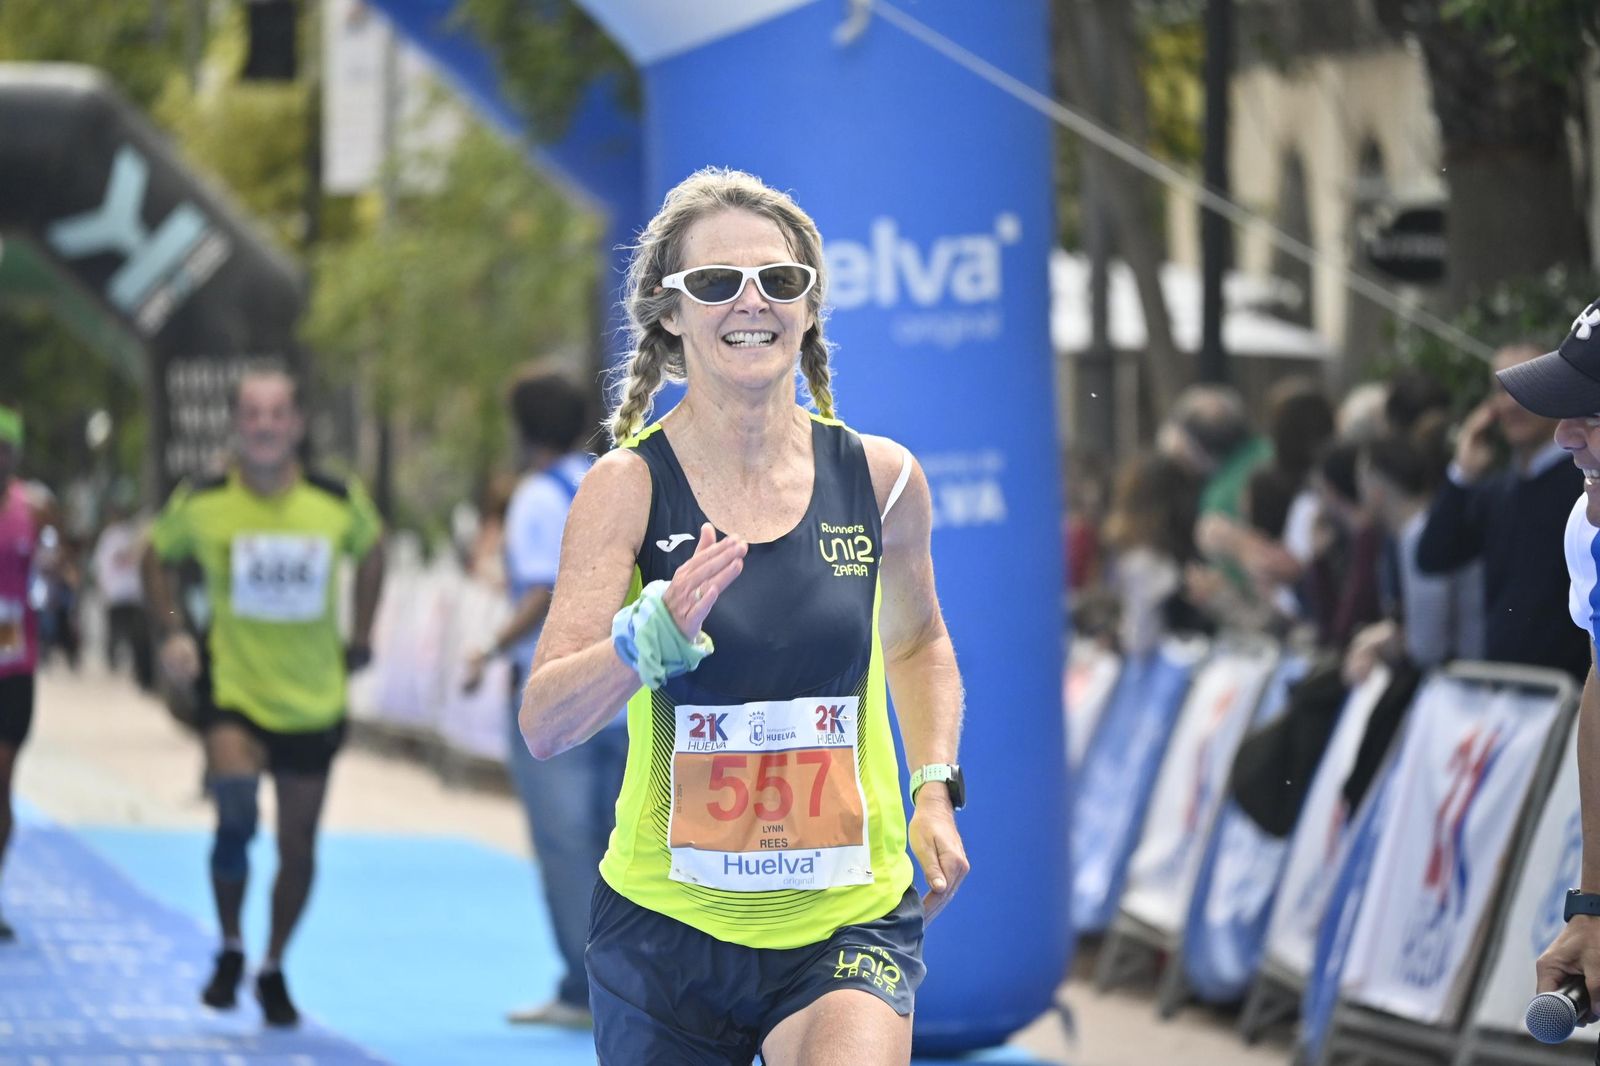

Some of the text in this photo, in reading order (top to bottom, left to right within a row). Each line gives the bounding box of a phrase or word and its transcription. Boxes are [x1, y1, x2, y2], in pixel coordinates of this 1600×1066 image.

[821, 522, 865, 534] Runners
[831, 564, 869, 577] ZAFRA
[815, 704, 847, 734] 21K
[688, 713, 729, 742] 21K
[766, 731, 797, 742] HUELVA
[817, 733, 846, 745] HUELVA
[687, 740, 727, 752] HUELVA
[706, 750, 833, 822] 557
[762, 825, 784, 834] LYNN
[760, 838, 788, 849] REES
[723, 852, 814, 875] Huelva
[783, 874, 815, 886] original
[833, 966, 897, 996] ZAFRA
